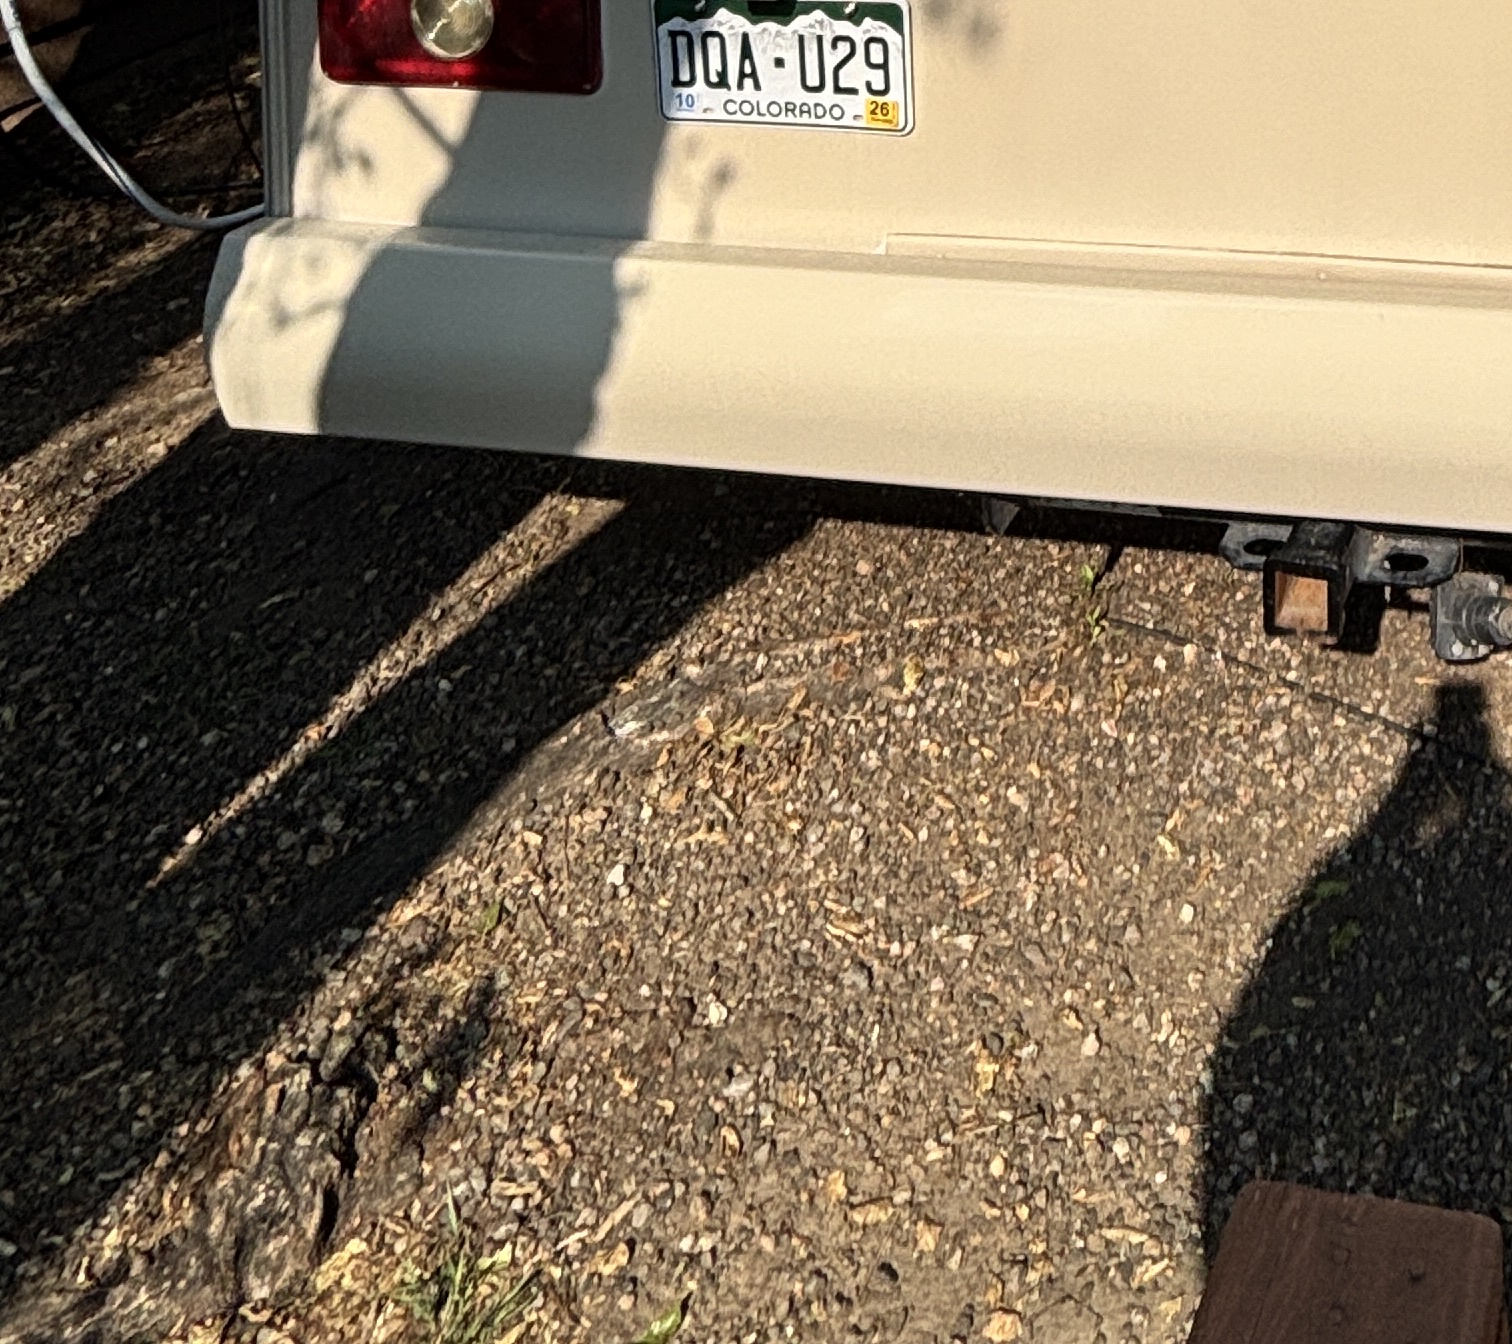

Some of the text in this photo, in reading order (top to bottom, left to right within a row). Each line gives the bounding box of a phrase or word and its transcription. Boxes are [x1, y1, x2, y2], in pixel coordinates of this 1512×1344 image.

[676, 93, 695, 108] 10
[723, 99, 845, 120] COLORADO
[870, 101, 890, 117] 26
